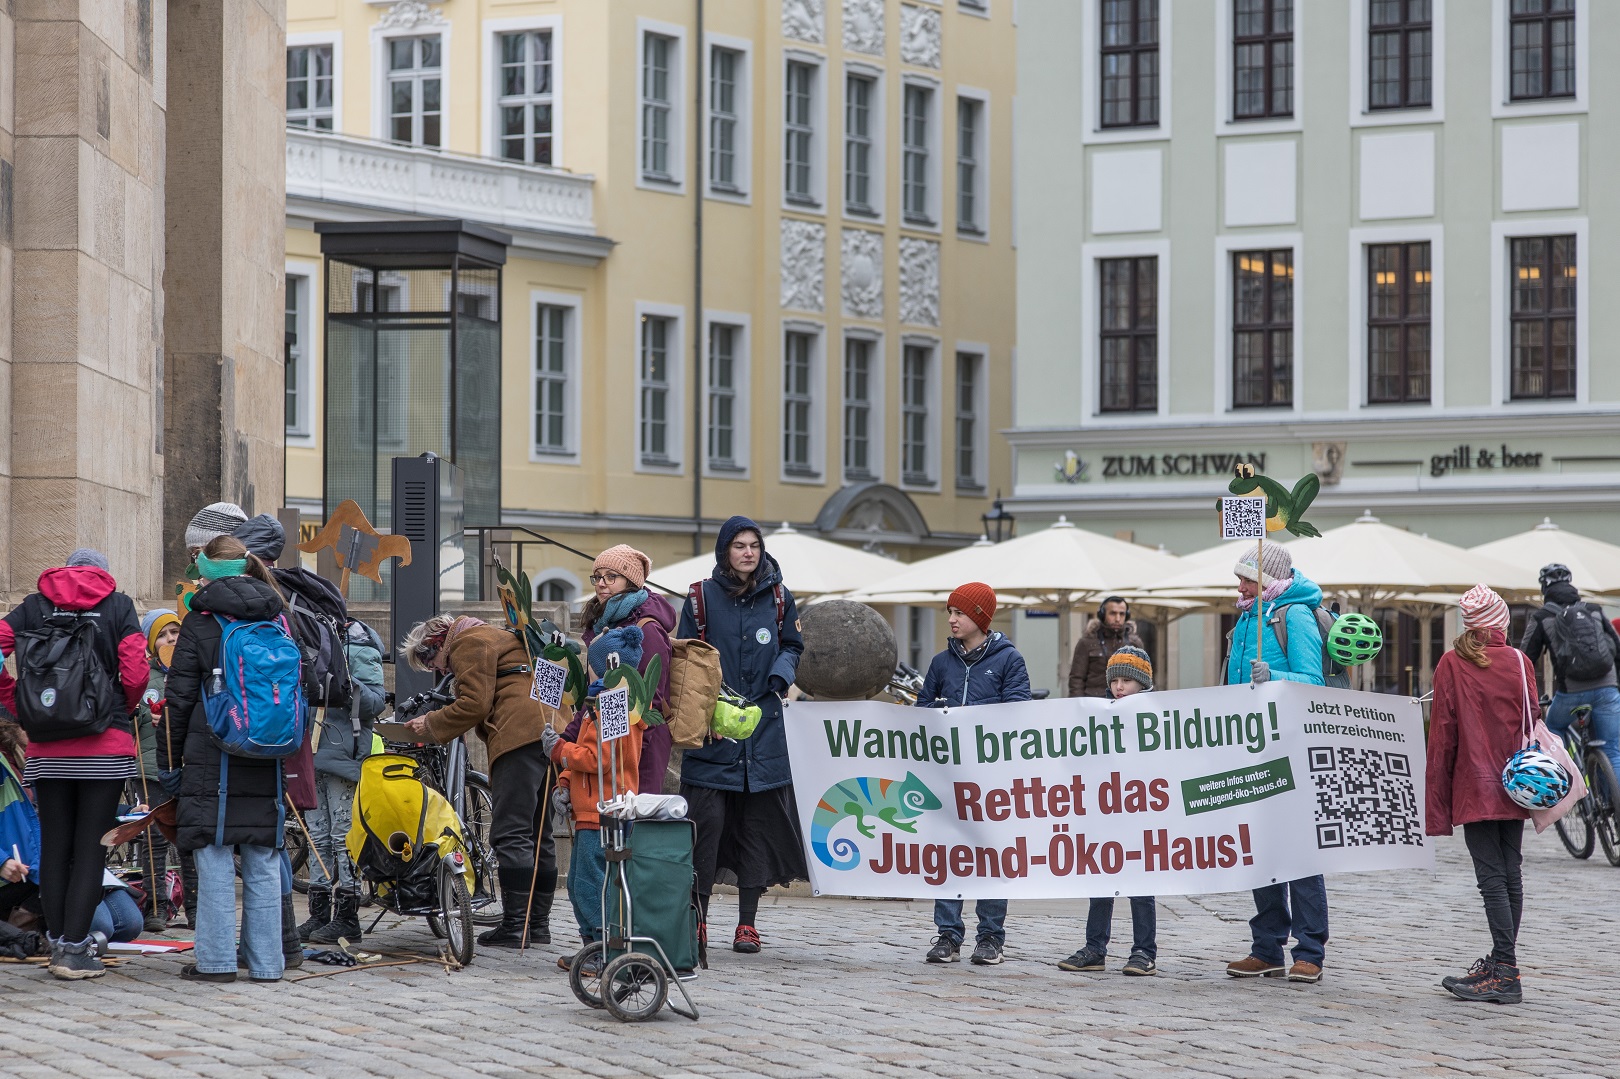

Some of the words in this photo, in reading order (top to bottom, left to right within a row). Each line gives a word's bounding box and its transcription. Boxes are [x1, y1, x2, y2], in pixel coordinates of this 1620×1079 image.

[1102, 456, 1155, 476] ZUM
[1162, 453, 1266, 476] SCHWAN
[1431, 445, 1470, 477] grill
[1477, 448, 1495, 468] &
[1501, 444, 1542, 468] beer
[1308, 701, 1341, 716] Jetzt
[1344, 705, 1396, 723] Petition
[823, 719, 962, 765] Wandel
[975, 715, 1125, 763] braucht
[1136, 702, 1280, 753] Bildung!
[1303, 721, 1406, 743] unterzeichnen:
[1189, 778, 1288, 808] www.jugend-öko-haus.de
[1199, 780, 1226, 793] weitere
[1226, 775, 1244, 787] Infos
[1245, 769, 1271, 783] unter:
[953, 774, 1086, 822] Rettet
[1098, 771, 1170, 815] das
[869, 823, 1254, 886] Jugend-Öko-Haus!
